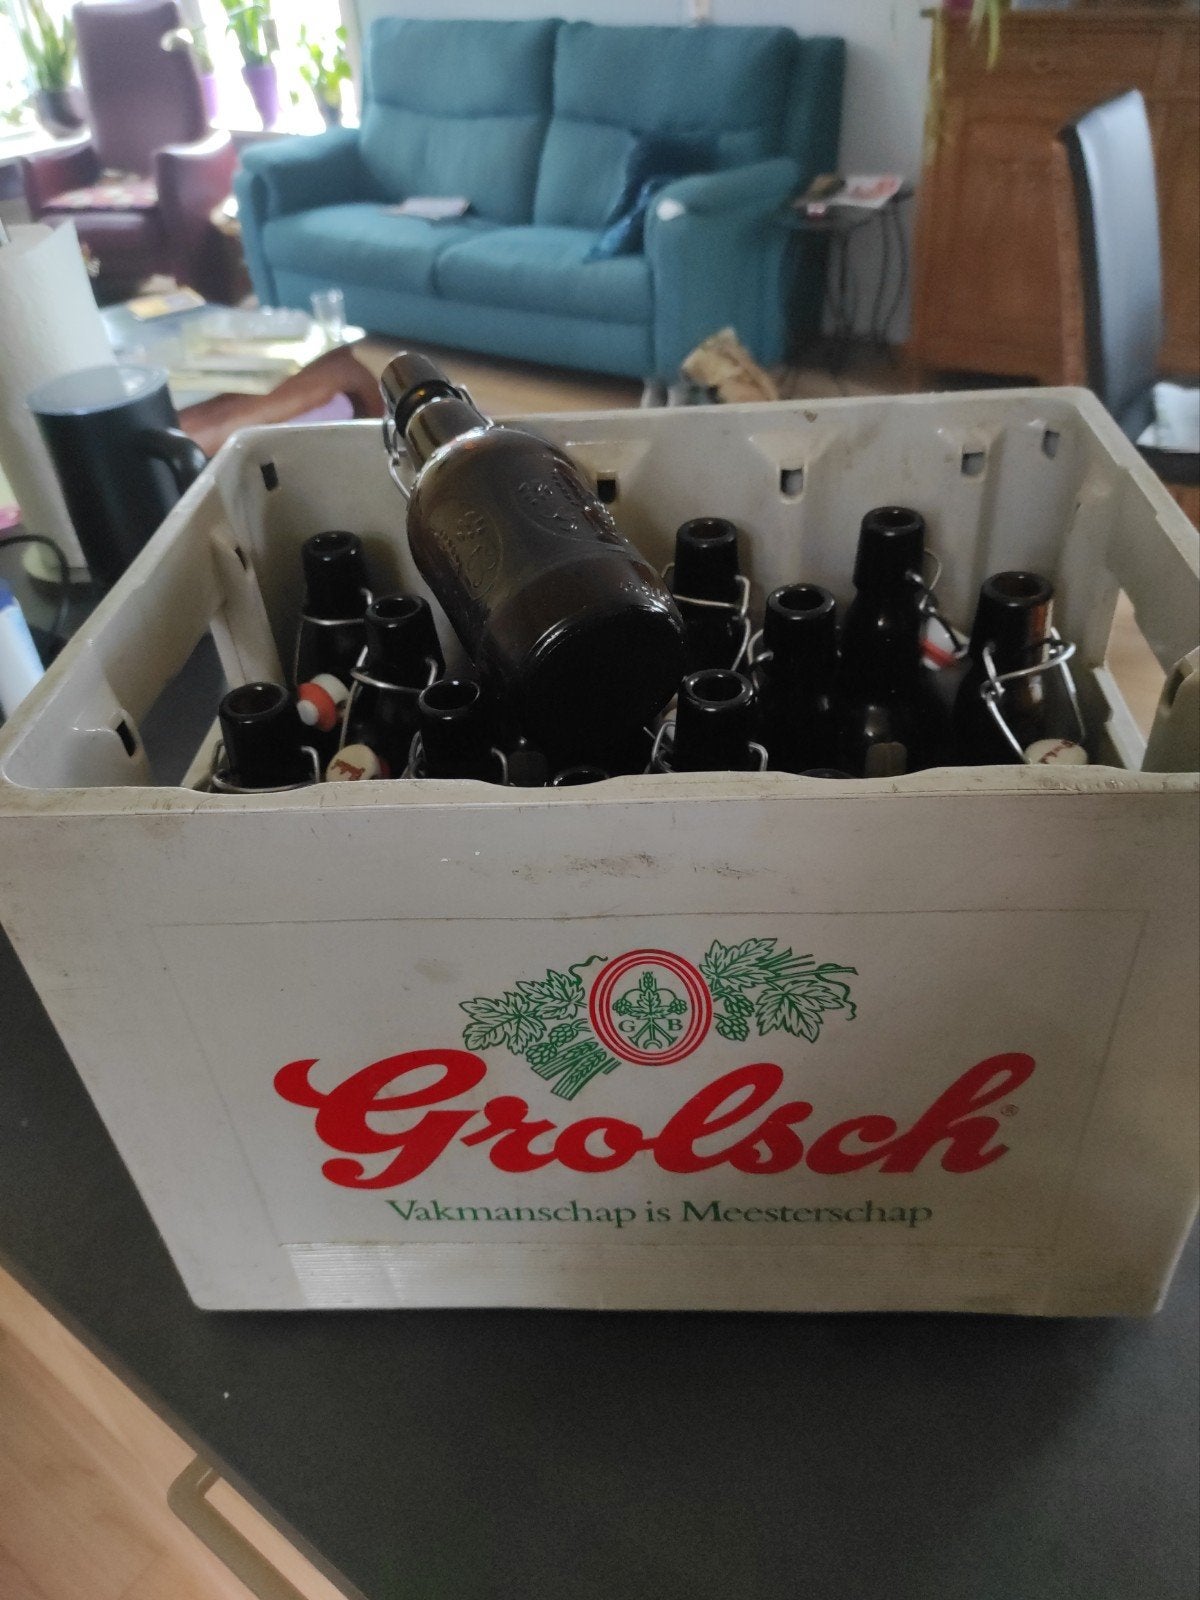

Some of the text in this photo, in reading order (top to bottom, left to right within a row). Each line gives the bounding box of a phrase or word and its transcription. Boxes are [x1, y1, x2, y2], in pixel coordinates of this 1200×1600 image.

[618, 1019, 684, 1033] G B
[273, 1049, 1036, 1190] Grolsch
[386, 1200, 933, 1229] Vakmanschap is Meesterschap
